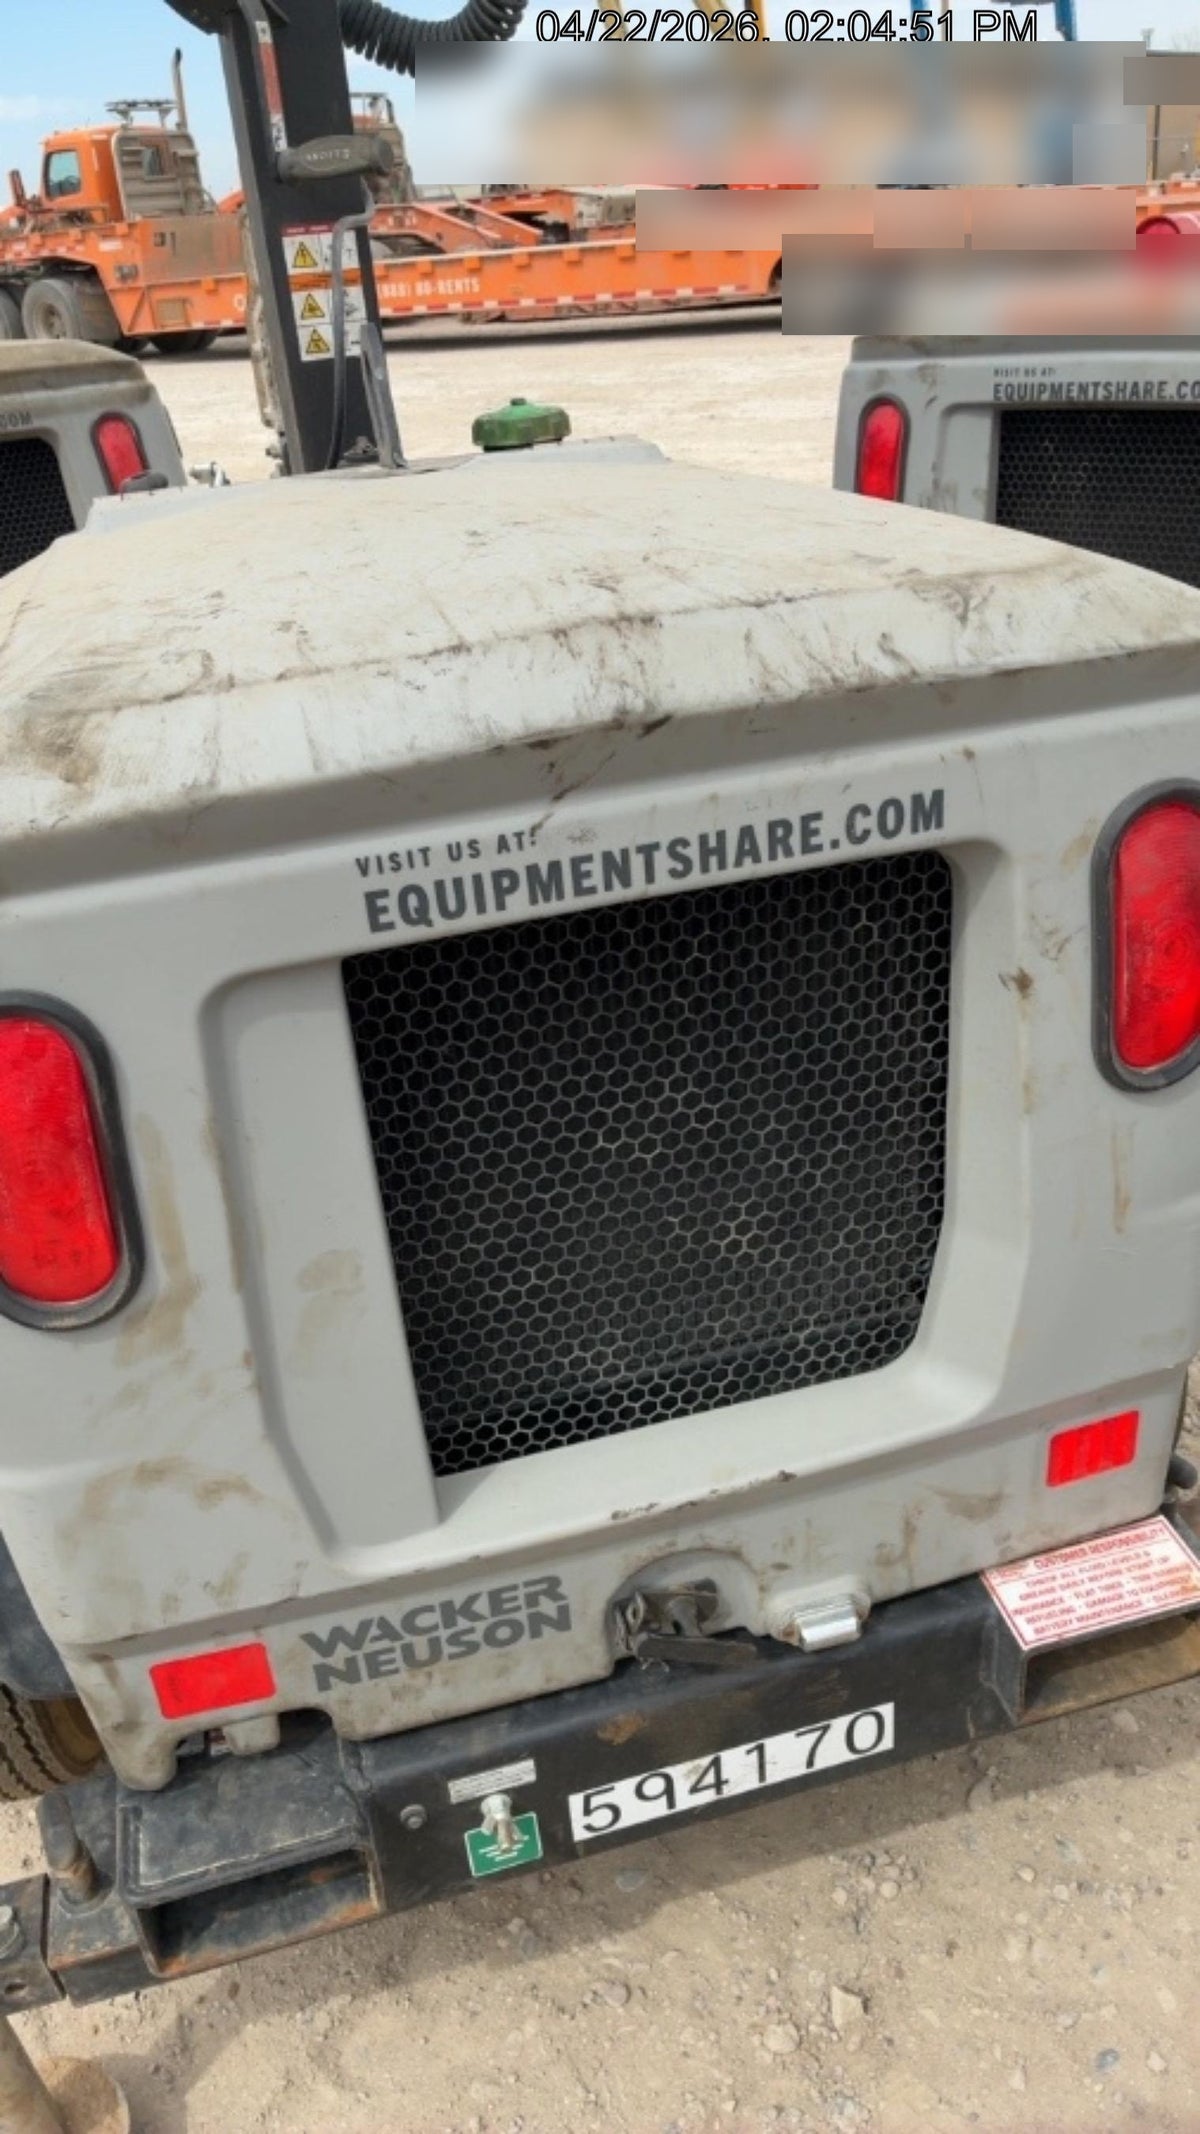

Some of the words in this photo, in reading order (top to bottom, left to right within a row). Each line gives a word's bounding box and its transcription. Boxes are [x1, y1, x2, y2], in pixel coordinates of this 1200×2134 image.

[993, 380, 1200, 401] EQUIPMENTSHARE.CO
[355, 847, 431, 878] VISIT
[447, 839, 482, 862] US
[364, 789, 945, 934] EQUIPMENTSHARE.COM
[300, 1575, 568, 1658] WACKER
[313, 1604, 573, 1692] NEUSON
[582, 1709, 886, 1833] 594170
